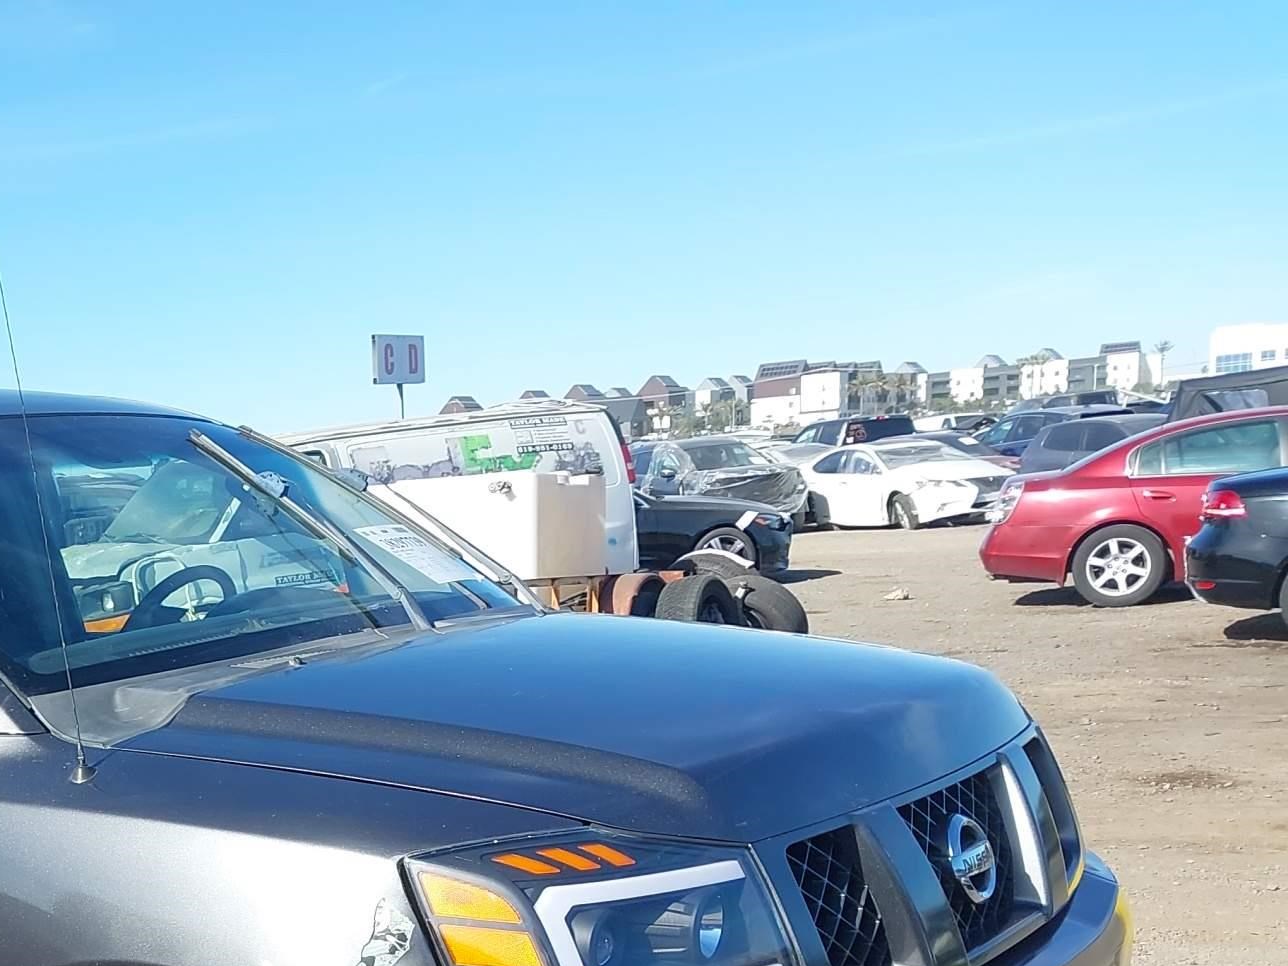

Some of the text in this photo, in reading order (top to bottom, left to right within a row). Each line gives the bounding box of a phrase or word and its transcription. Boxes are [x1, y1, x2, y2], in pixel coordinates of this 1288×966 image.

[384, 343, 418, 375] C D
[276, 572, 313, 585] TAYLOR
